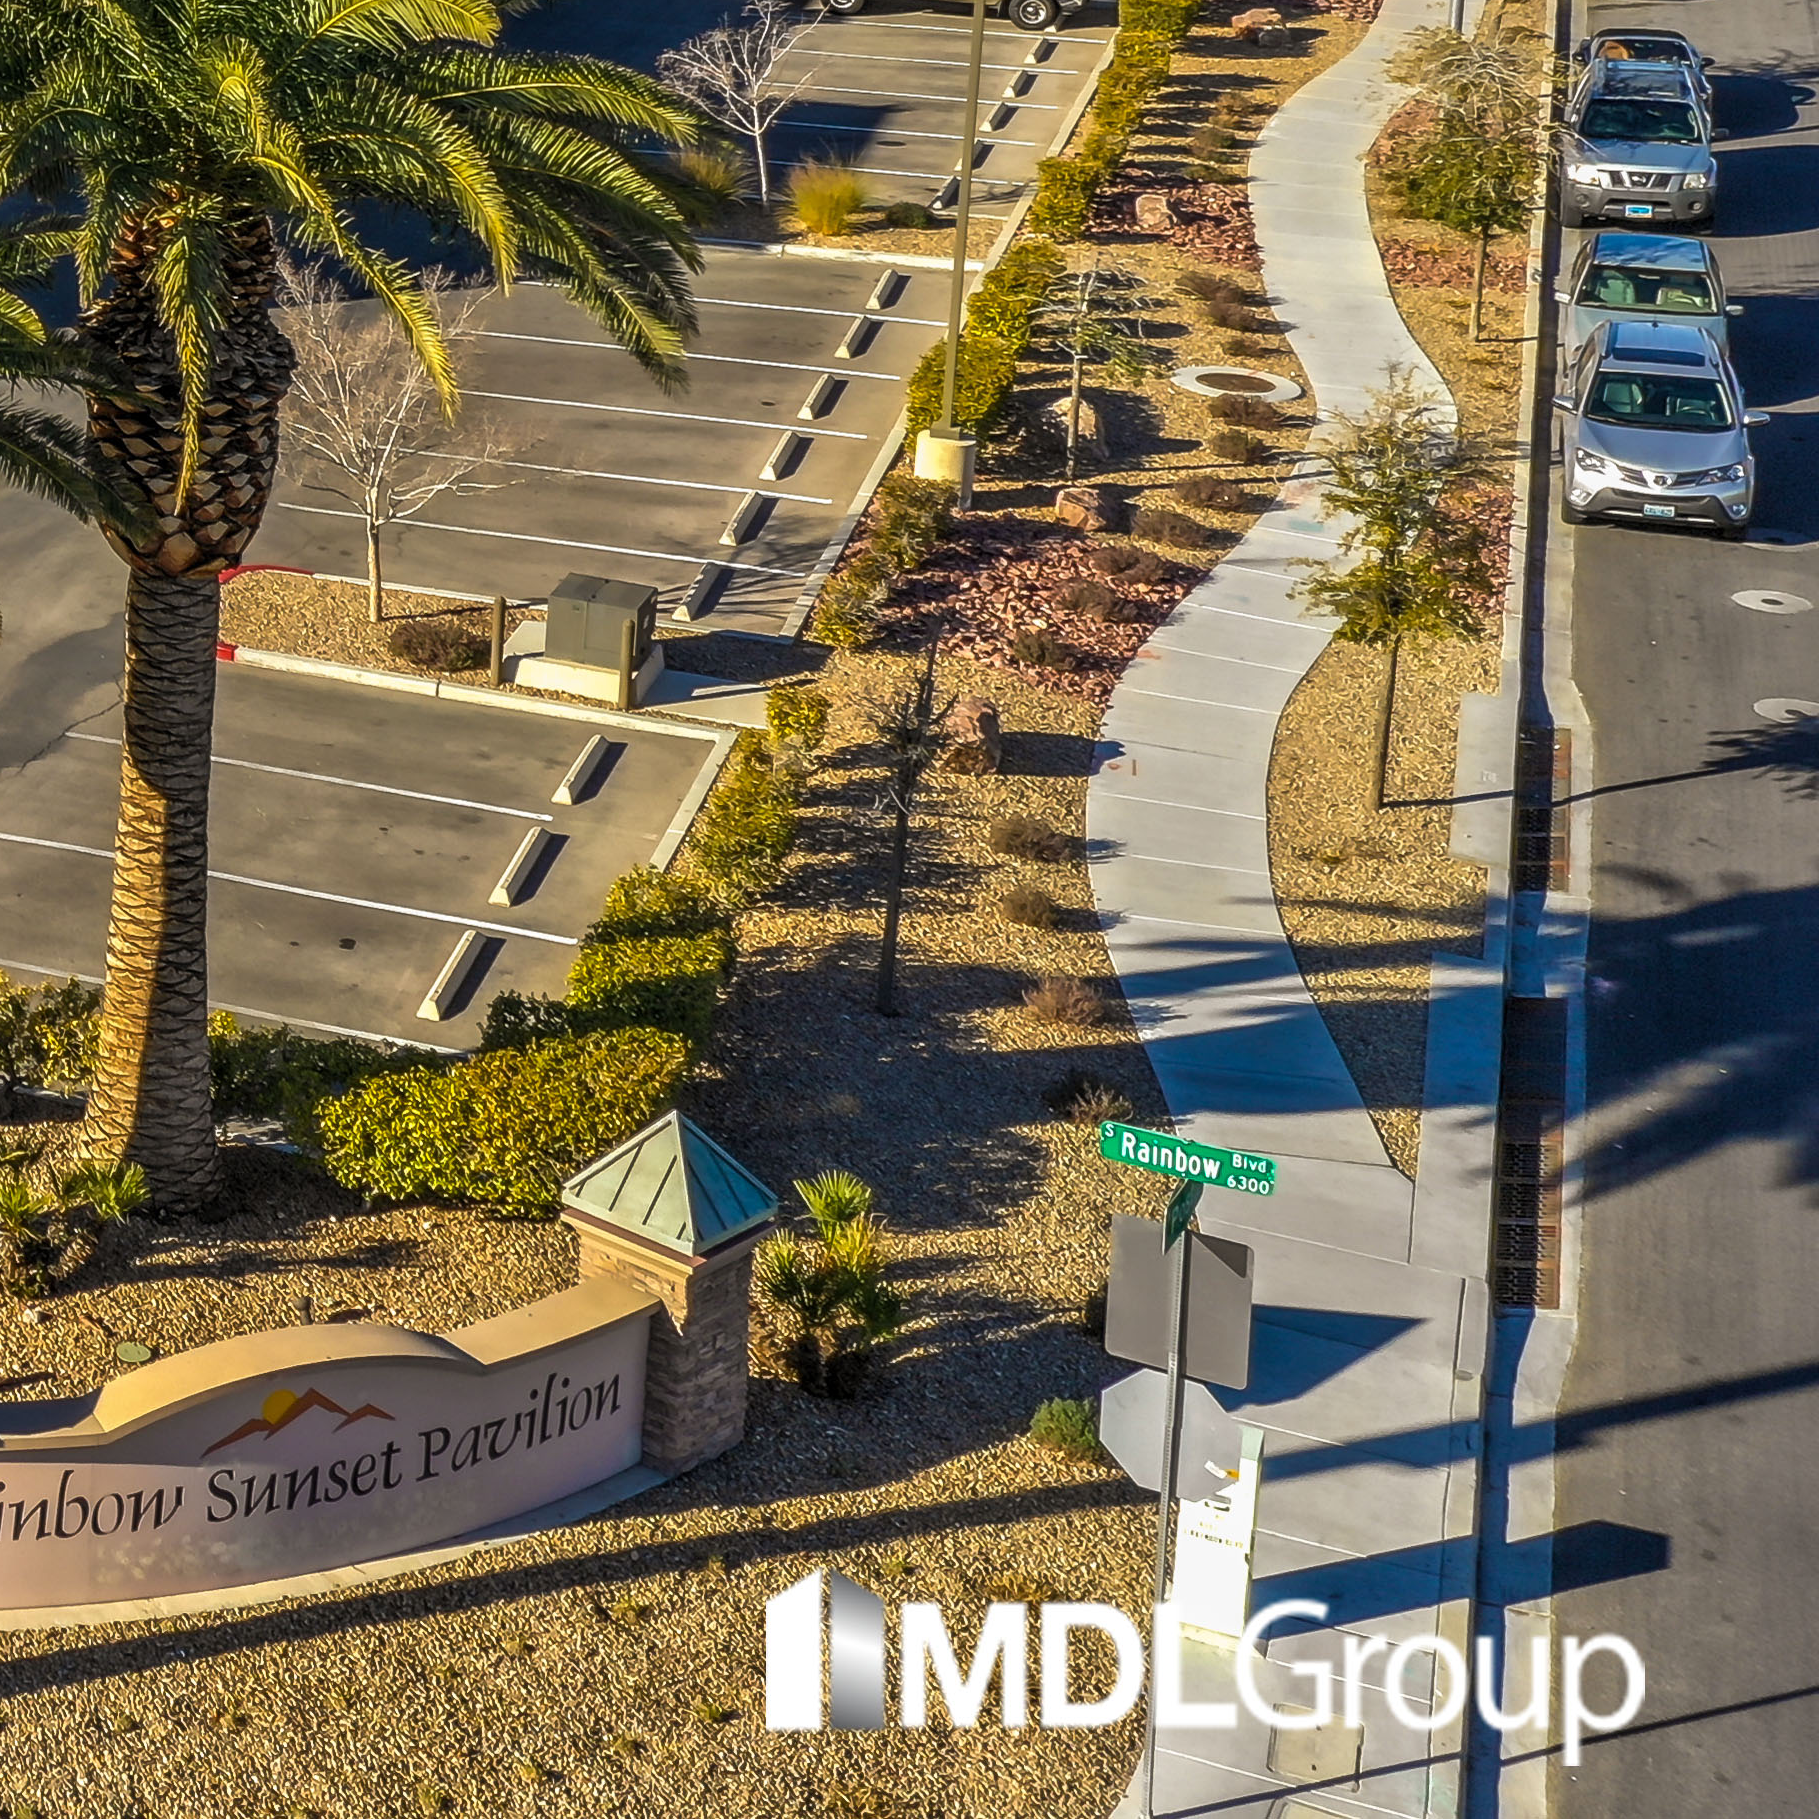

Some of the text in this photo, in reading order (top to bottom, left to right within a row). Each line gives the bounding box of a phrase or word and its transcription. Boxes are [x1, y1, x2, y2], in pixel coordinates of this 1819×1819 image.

[1104, 1123, 1268, 1180] S Rainbow Blvd
[1226, 1174, 1271, 1195] 6300
[205, 1440, 404, 1524] Sunset
[416, 1372, 623, 1483] Pavilion
